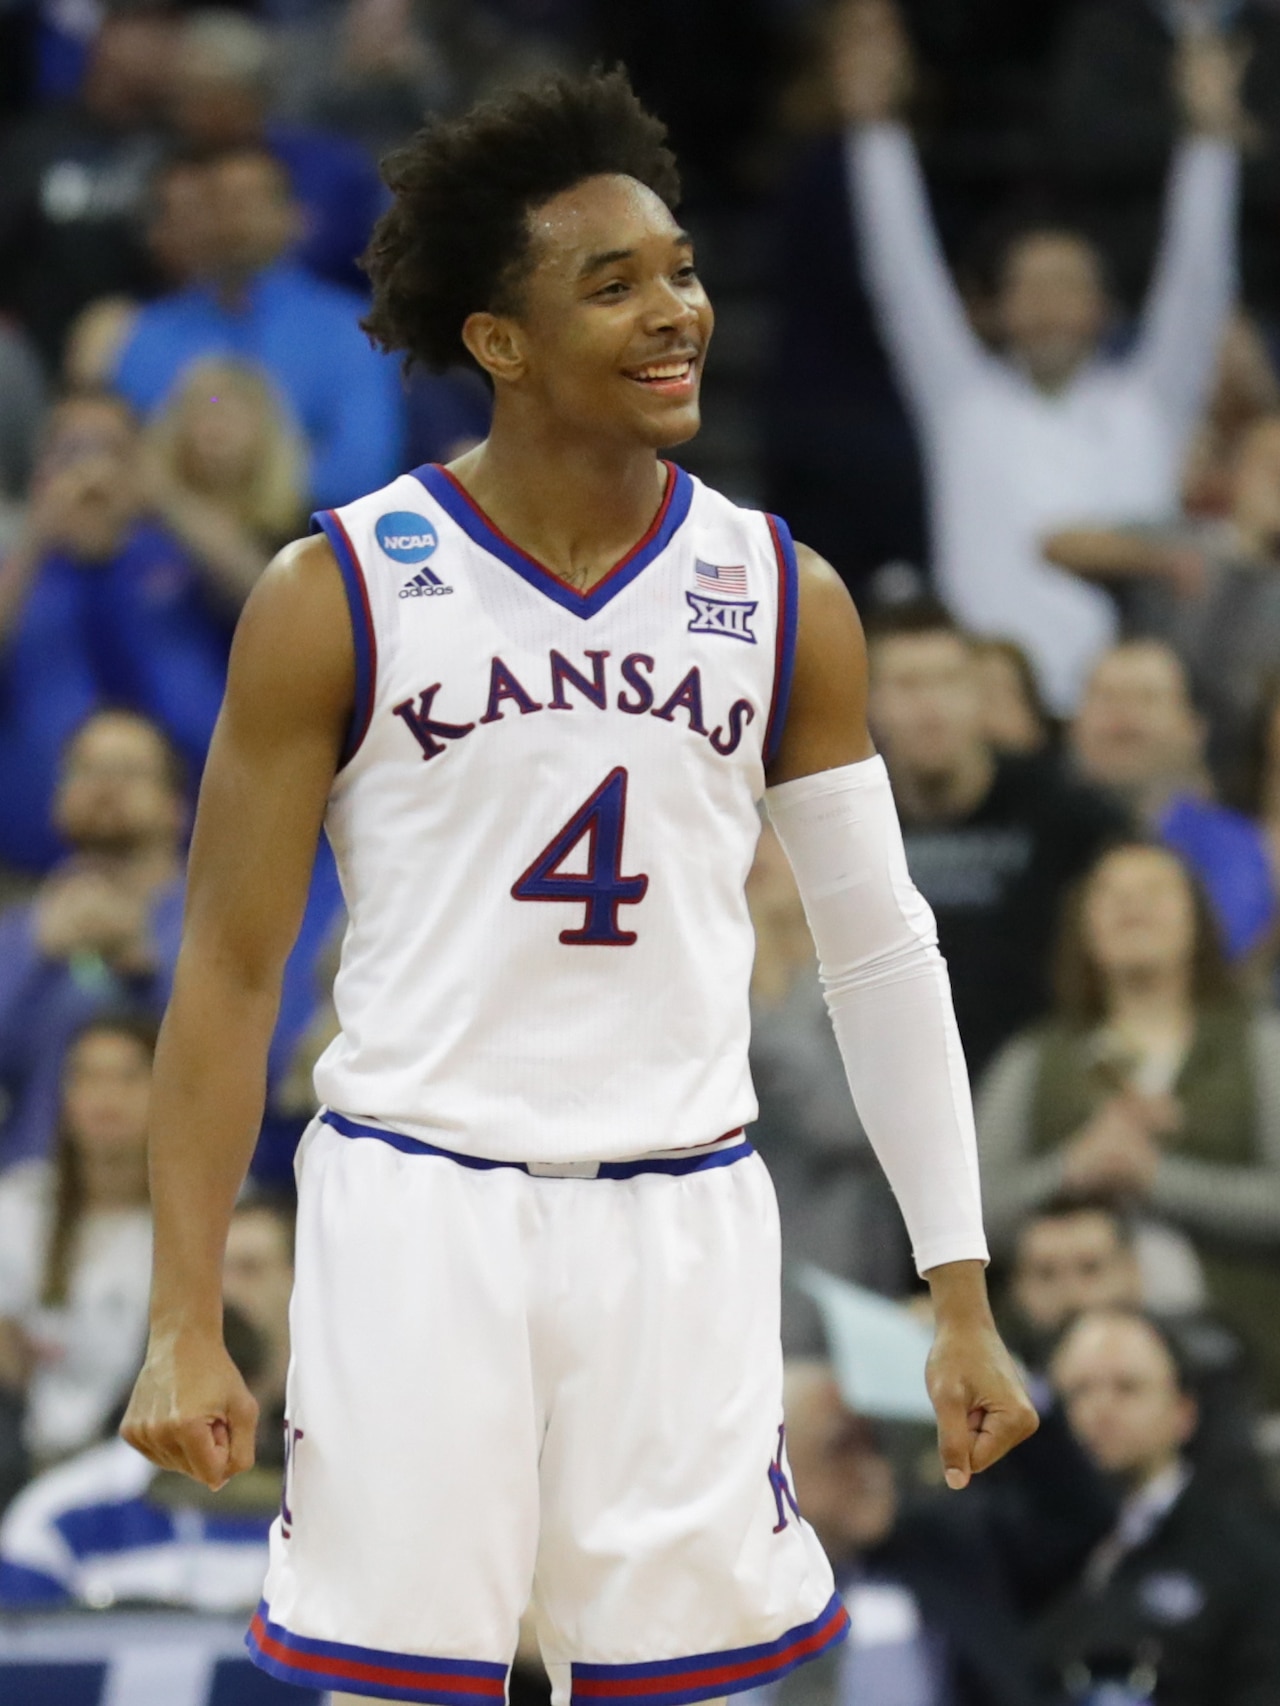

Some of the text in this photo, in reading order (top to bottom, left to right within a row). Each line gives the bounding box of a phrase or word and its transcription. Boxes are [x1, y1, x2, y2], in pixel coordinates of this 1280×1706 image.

[383, 533, 436, 550] NCAA
[398, 585, 454, 599] adidas
[685, 591, 759, 644] XII
[392, 649, 755, 761] KANSAS
[510, 765, 649, 946] 4
